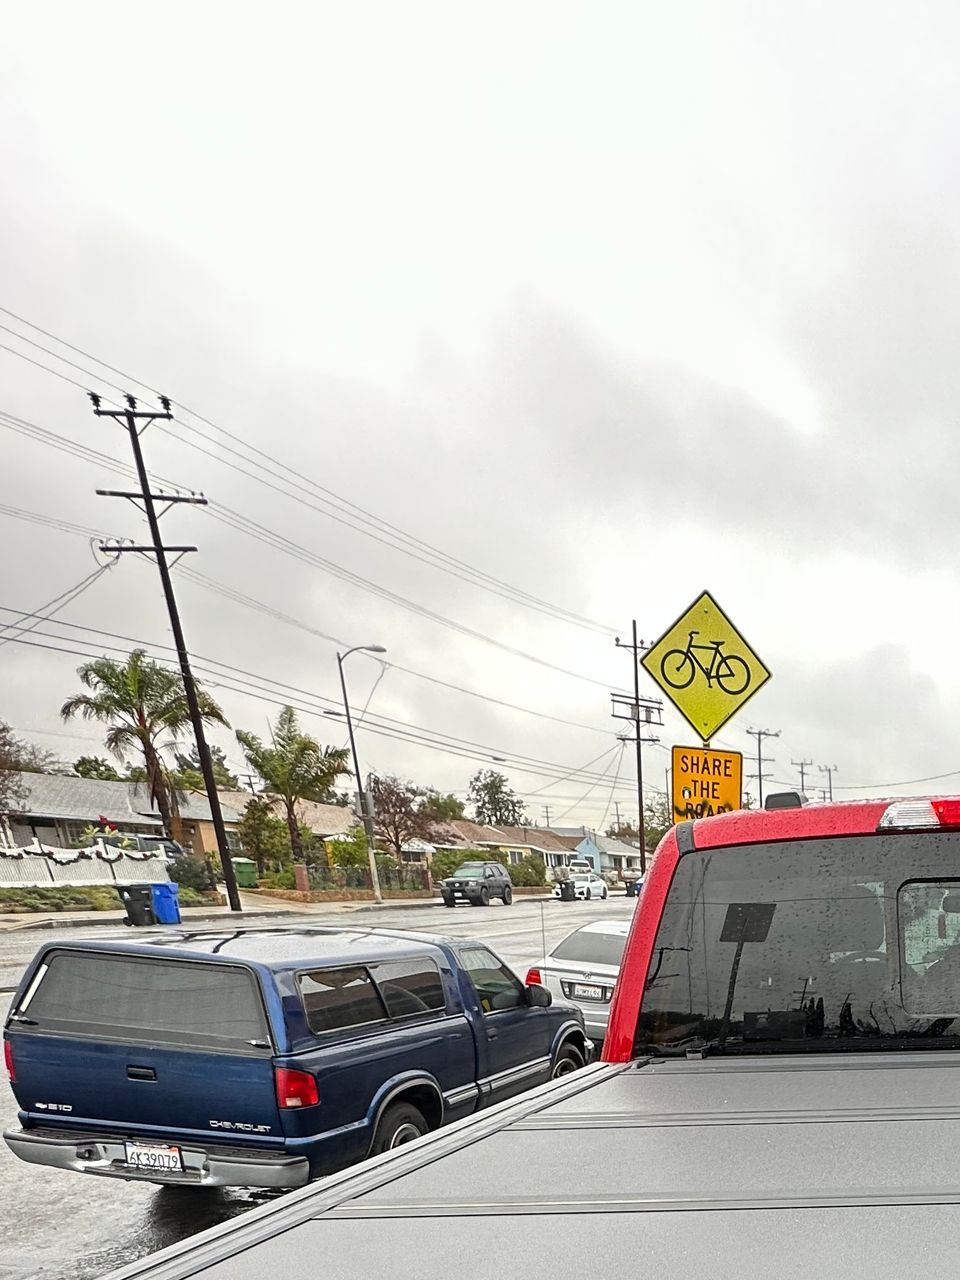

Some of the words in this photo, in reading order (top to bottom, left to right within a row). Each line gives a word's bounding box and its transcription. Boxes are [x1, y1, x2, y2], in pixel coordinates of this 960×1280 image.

[681, 755, 732, 777] SHARE
[691, 780, 720, 799] THE
[209, 1119, 272, 1133] CHEVROLET
